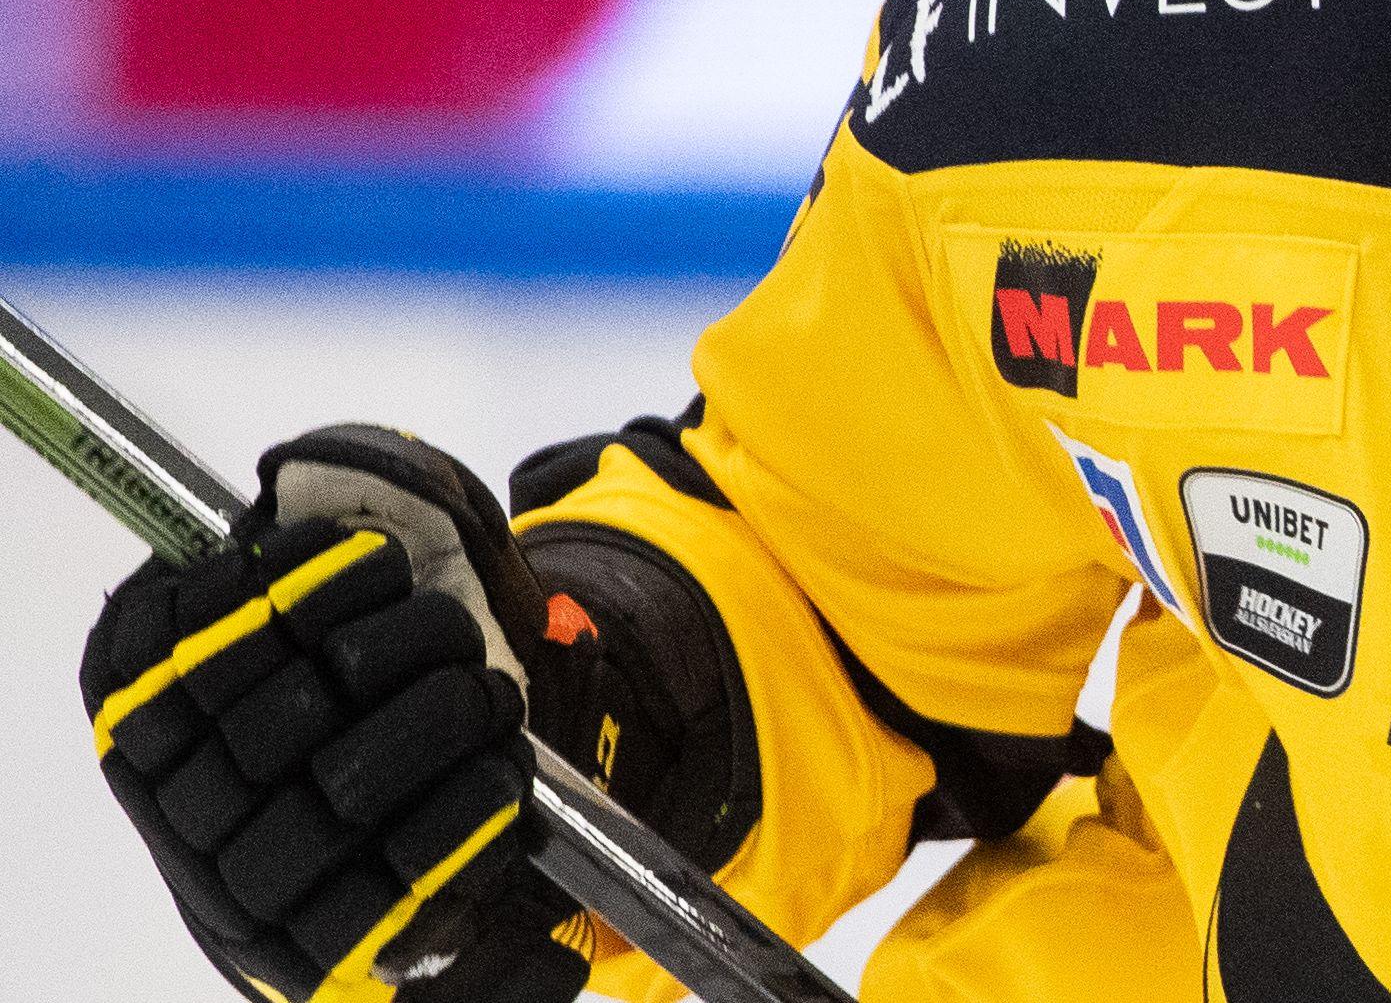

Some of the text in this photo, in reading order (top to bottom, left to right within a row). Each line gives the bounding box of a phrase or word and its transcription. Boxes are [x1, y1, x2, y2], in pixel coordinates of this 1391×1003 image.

[994, 286, 1334, 380] MARK
[1230, 495, 1330, 550] UNIBET
[1239, 585, 1322, 639] HOCKEY
